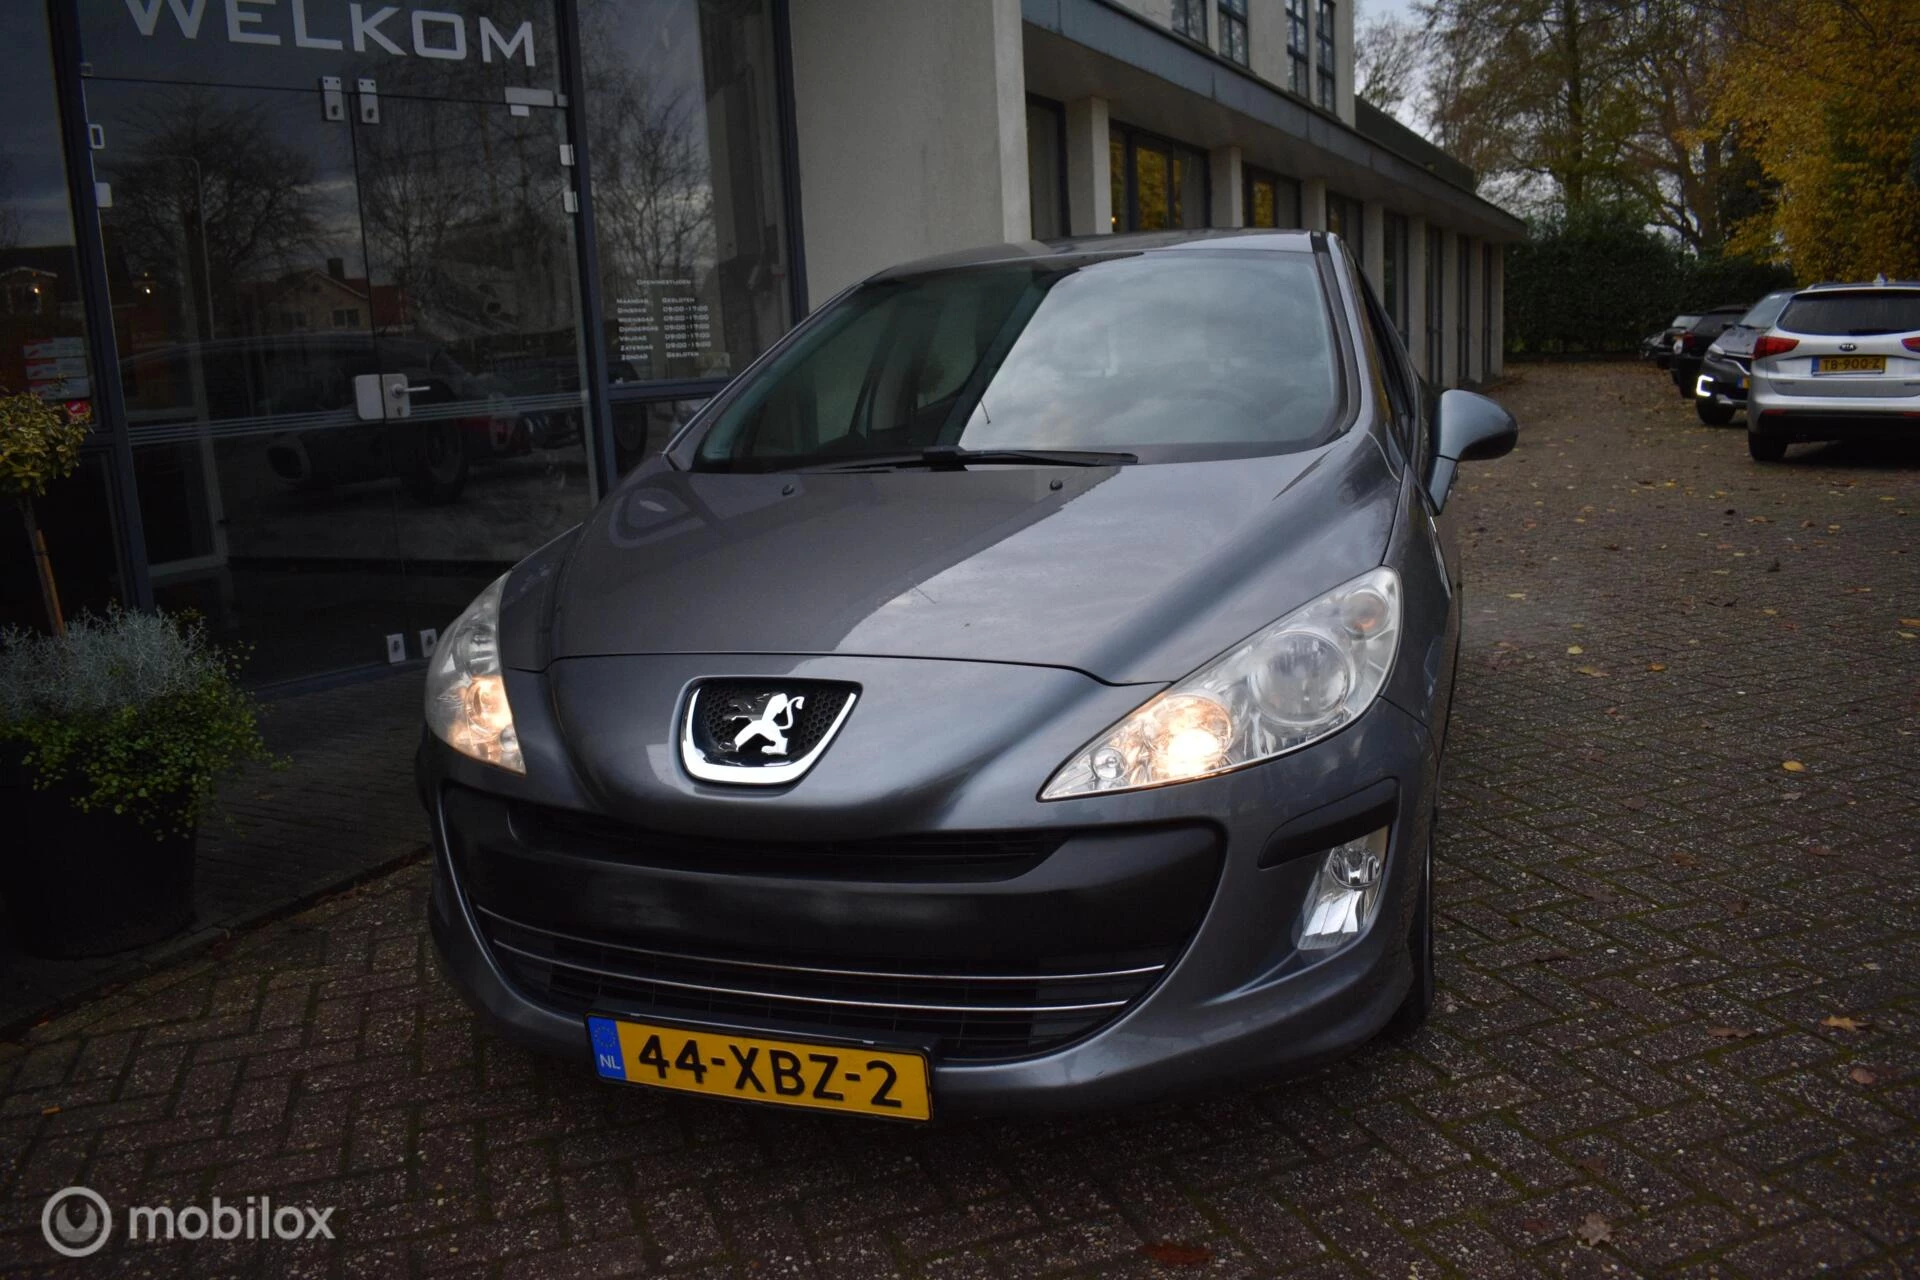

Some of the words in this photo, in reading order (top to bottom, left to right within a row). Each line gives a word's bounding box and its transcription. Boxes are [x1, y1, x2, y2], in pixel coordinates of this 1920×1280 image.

[123, 0, 536, 67] WELKOM
[600, 1053, 622, 1071] NL
[637, 1034, 903, 1109] 44-XBZ-2
